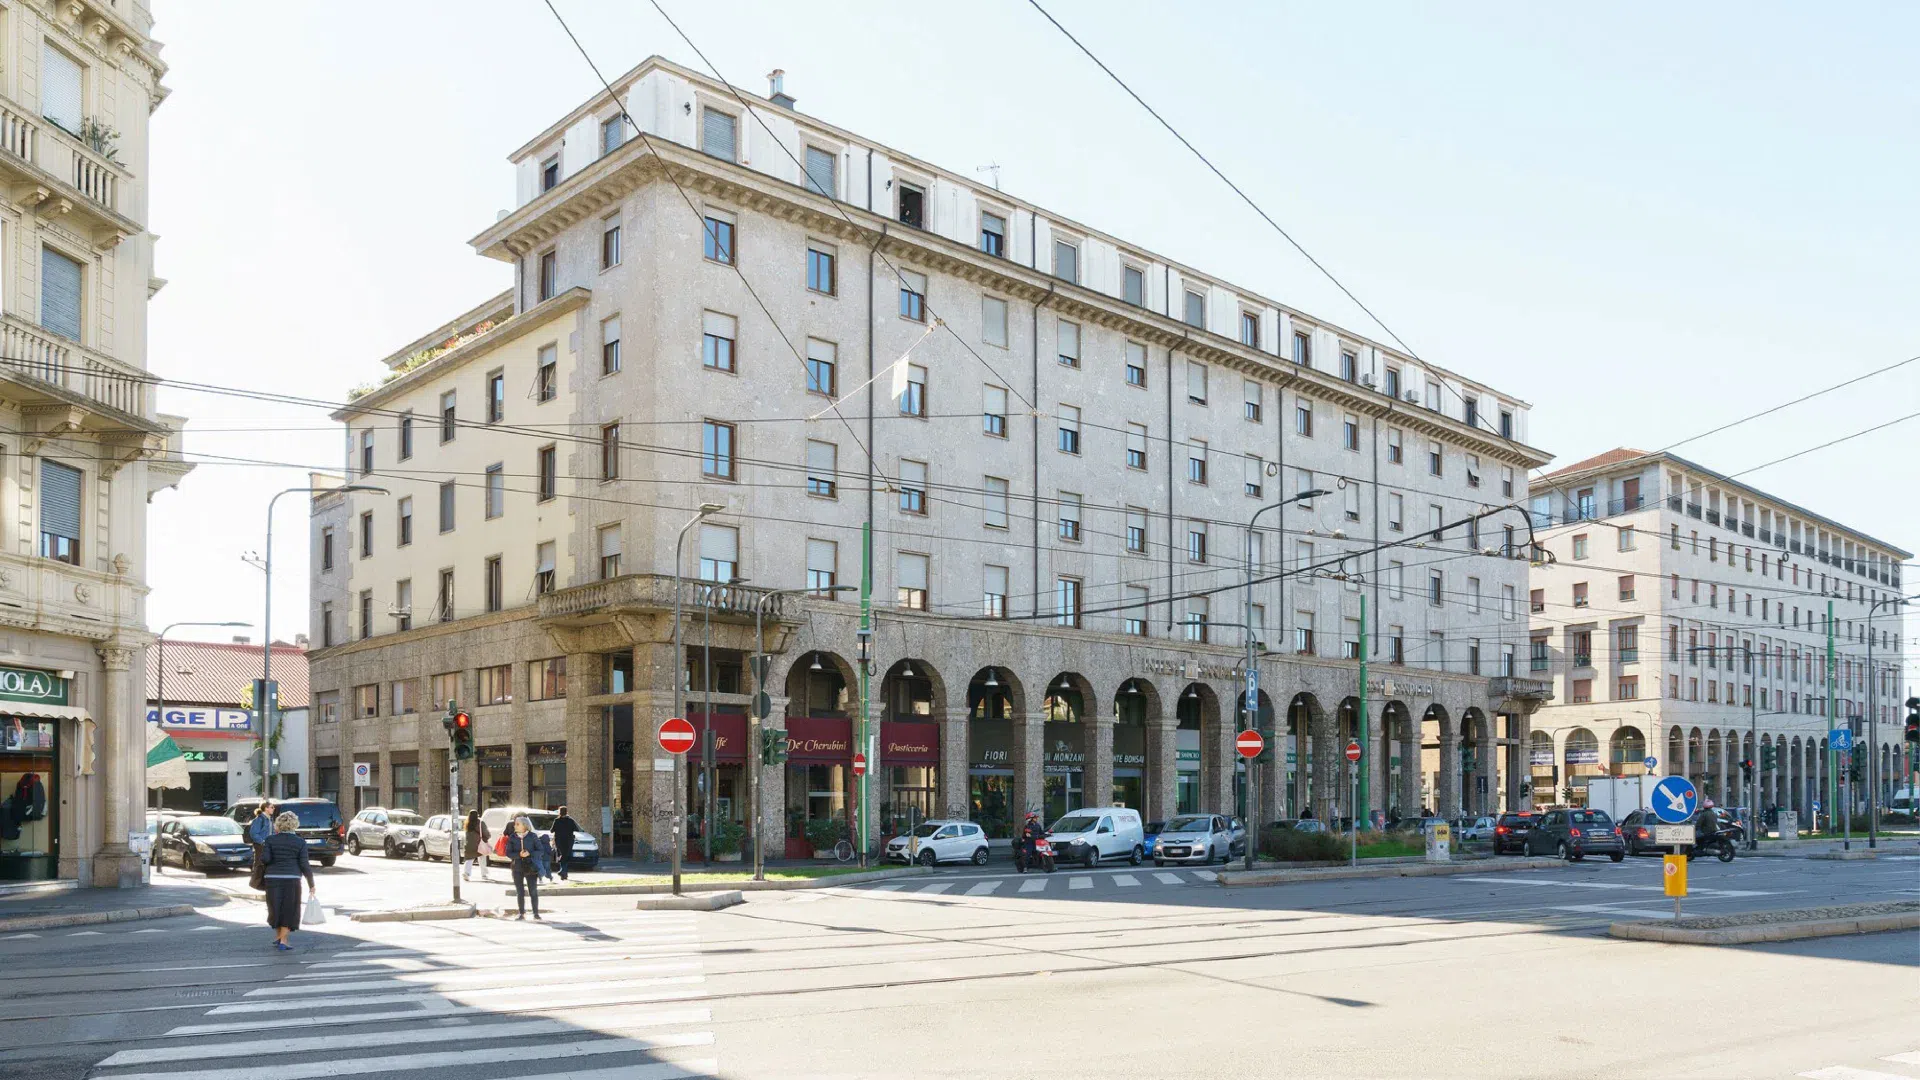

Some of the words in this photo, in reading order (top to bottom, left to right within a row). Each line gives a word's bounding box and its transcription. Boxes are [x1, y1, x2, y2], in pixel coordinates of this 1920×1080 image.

[804, 739, 848, 752] Cherubini
[984, 750, 1008, 761] FIORI
[1053, 752, 1085, 762] MONZANI
